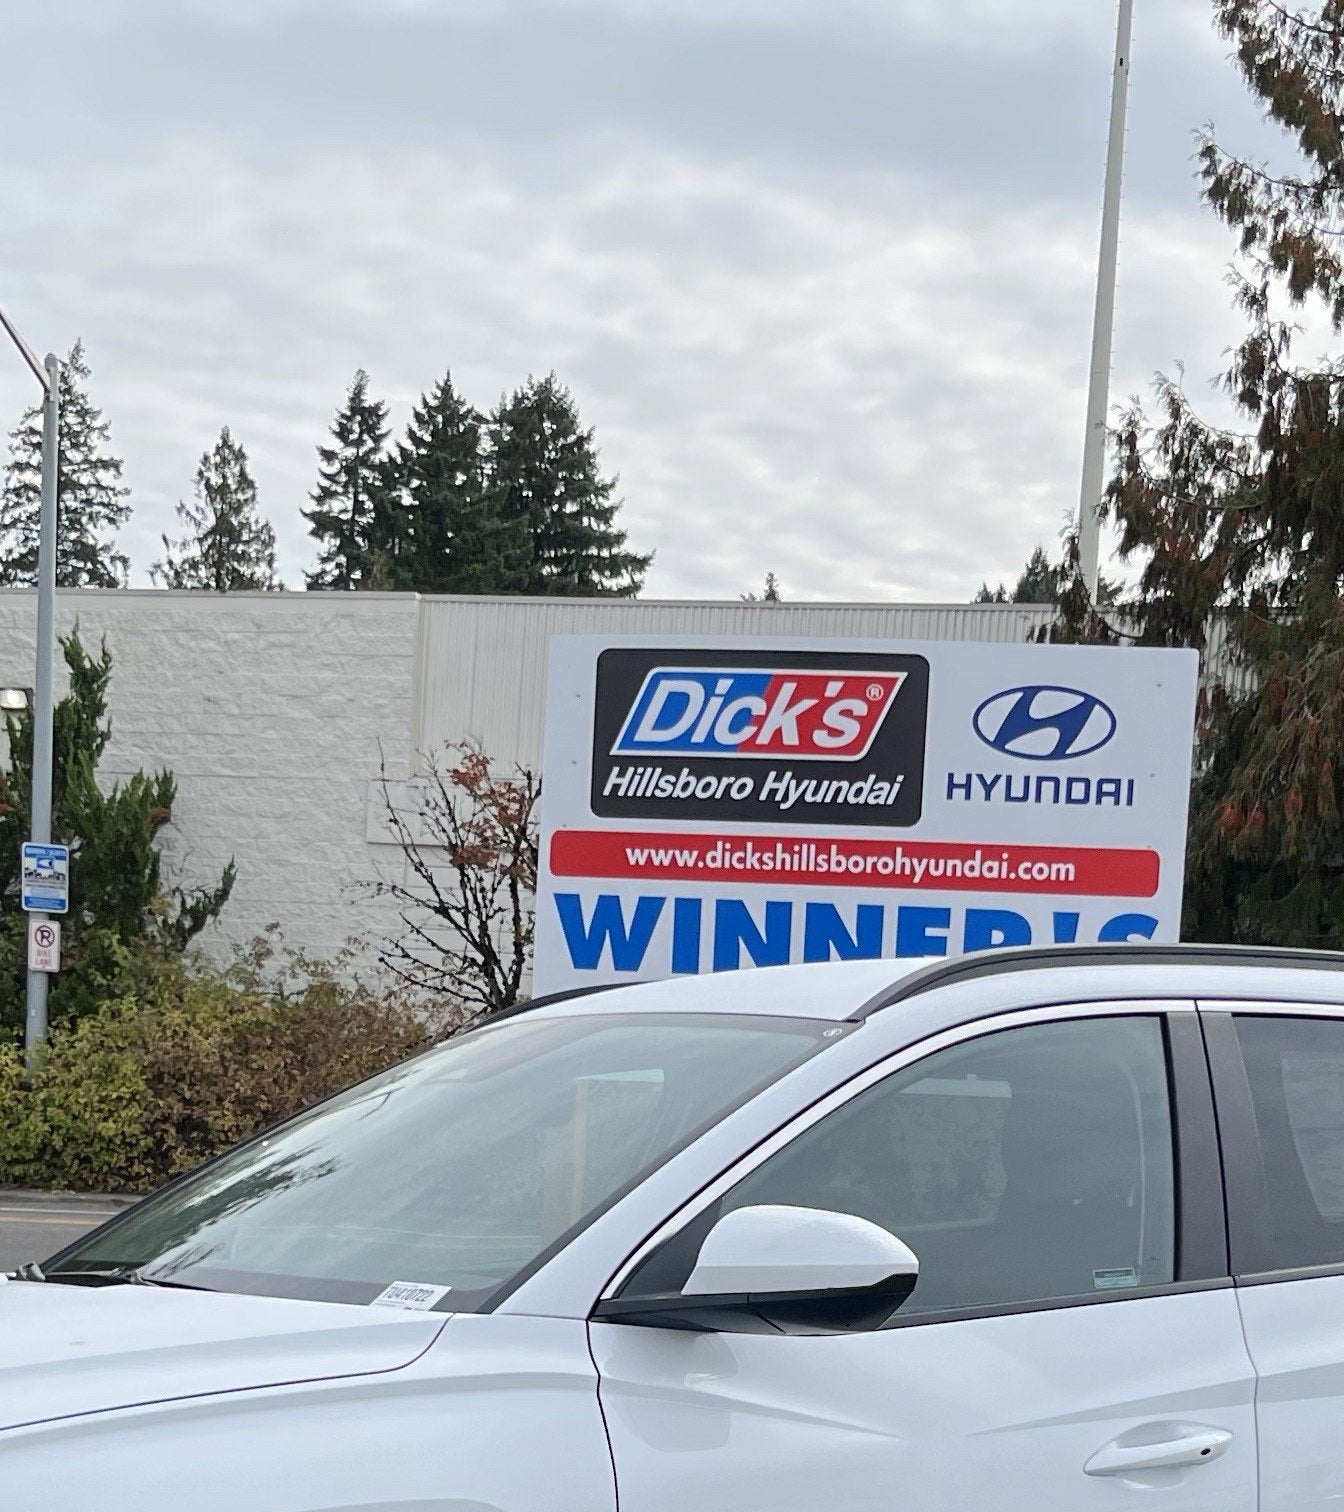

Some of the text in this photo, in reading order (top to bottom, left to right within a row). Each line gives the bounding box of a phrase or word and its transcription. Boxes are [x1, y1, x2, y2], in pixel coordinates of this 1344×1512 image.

[602, 766, 906, 810] Hillsboro Hyundai
[946, 772, 1135, 807] HYUNDAI
[625, 841, 1076, 883] www.dickshillsborohyundai.com
